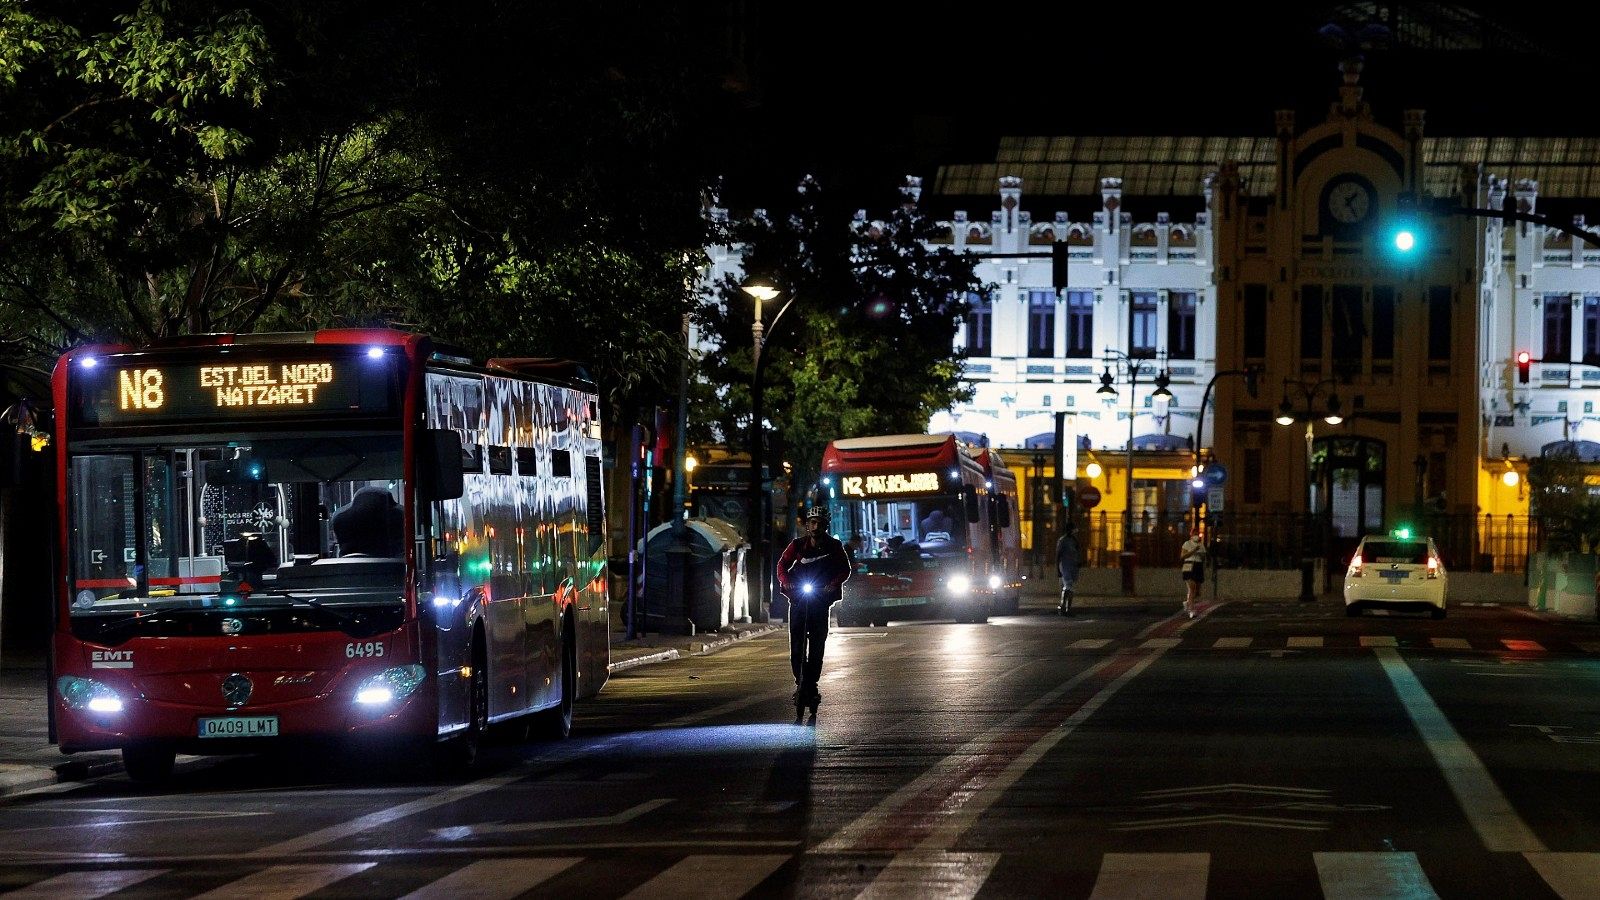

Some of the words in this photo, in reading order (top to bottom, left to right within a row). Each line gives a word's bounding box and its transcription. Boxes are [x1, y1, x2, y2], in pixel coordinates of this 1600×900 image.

[282, 363, 333, 384] NORD
[120, 369, 164, 409] N8
[216, 384, 318, 406] NATZARET
[92, 651, 134, 661] EMT
[345, 642, 384, 658] 6495
[208, 721, 244, 734] 0409
[248, 719, 275, 733] LMT
